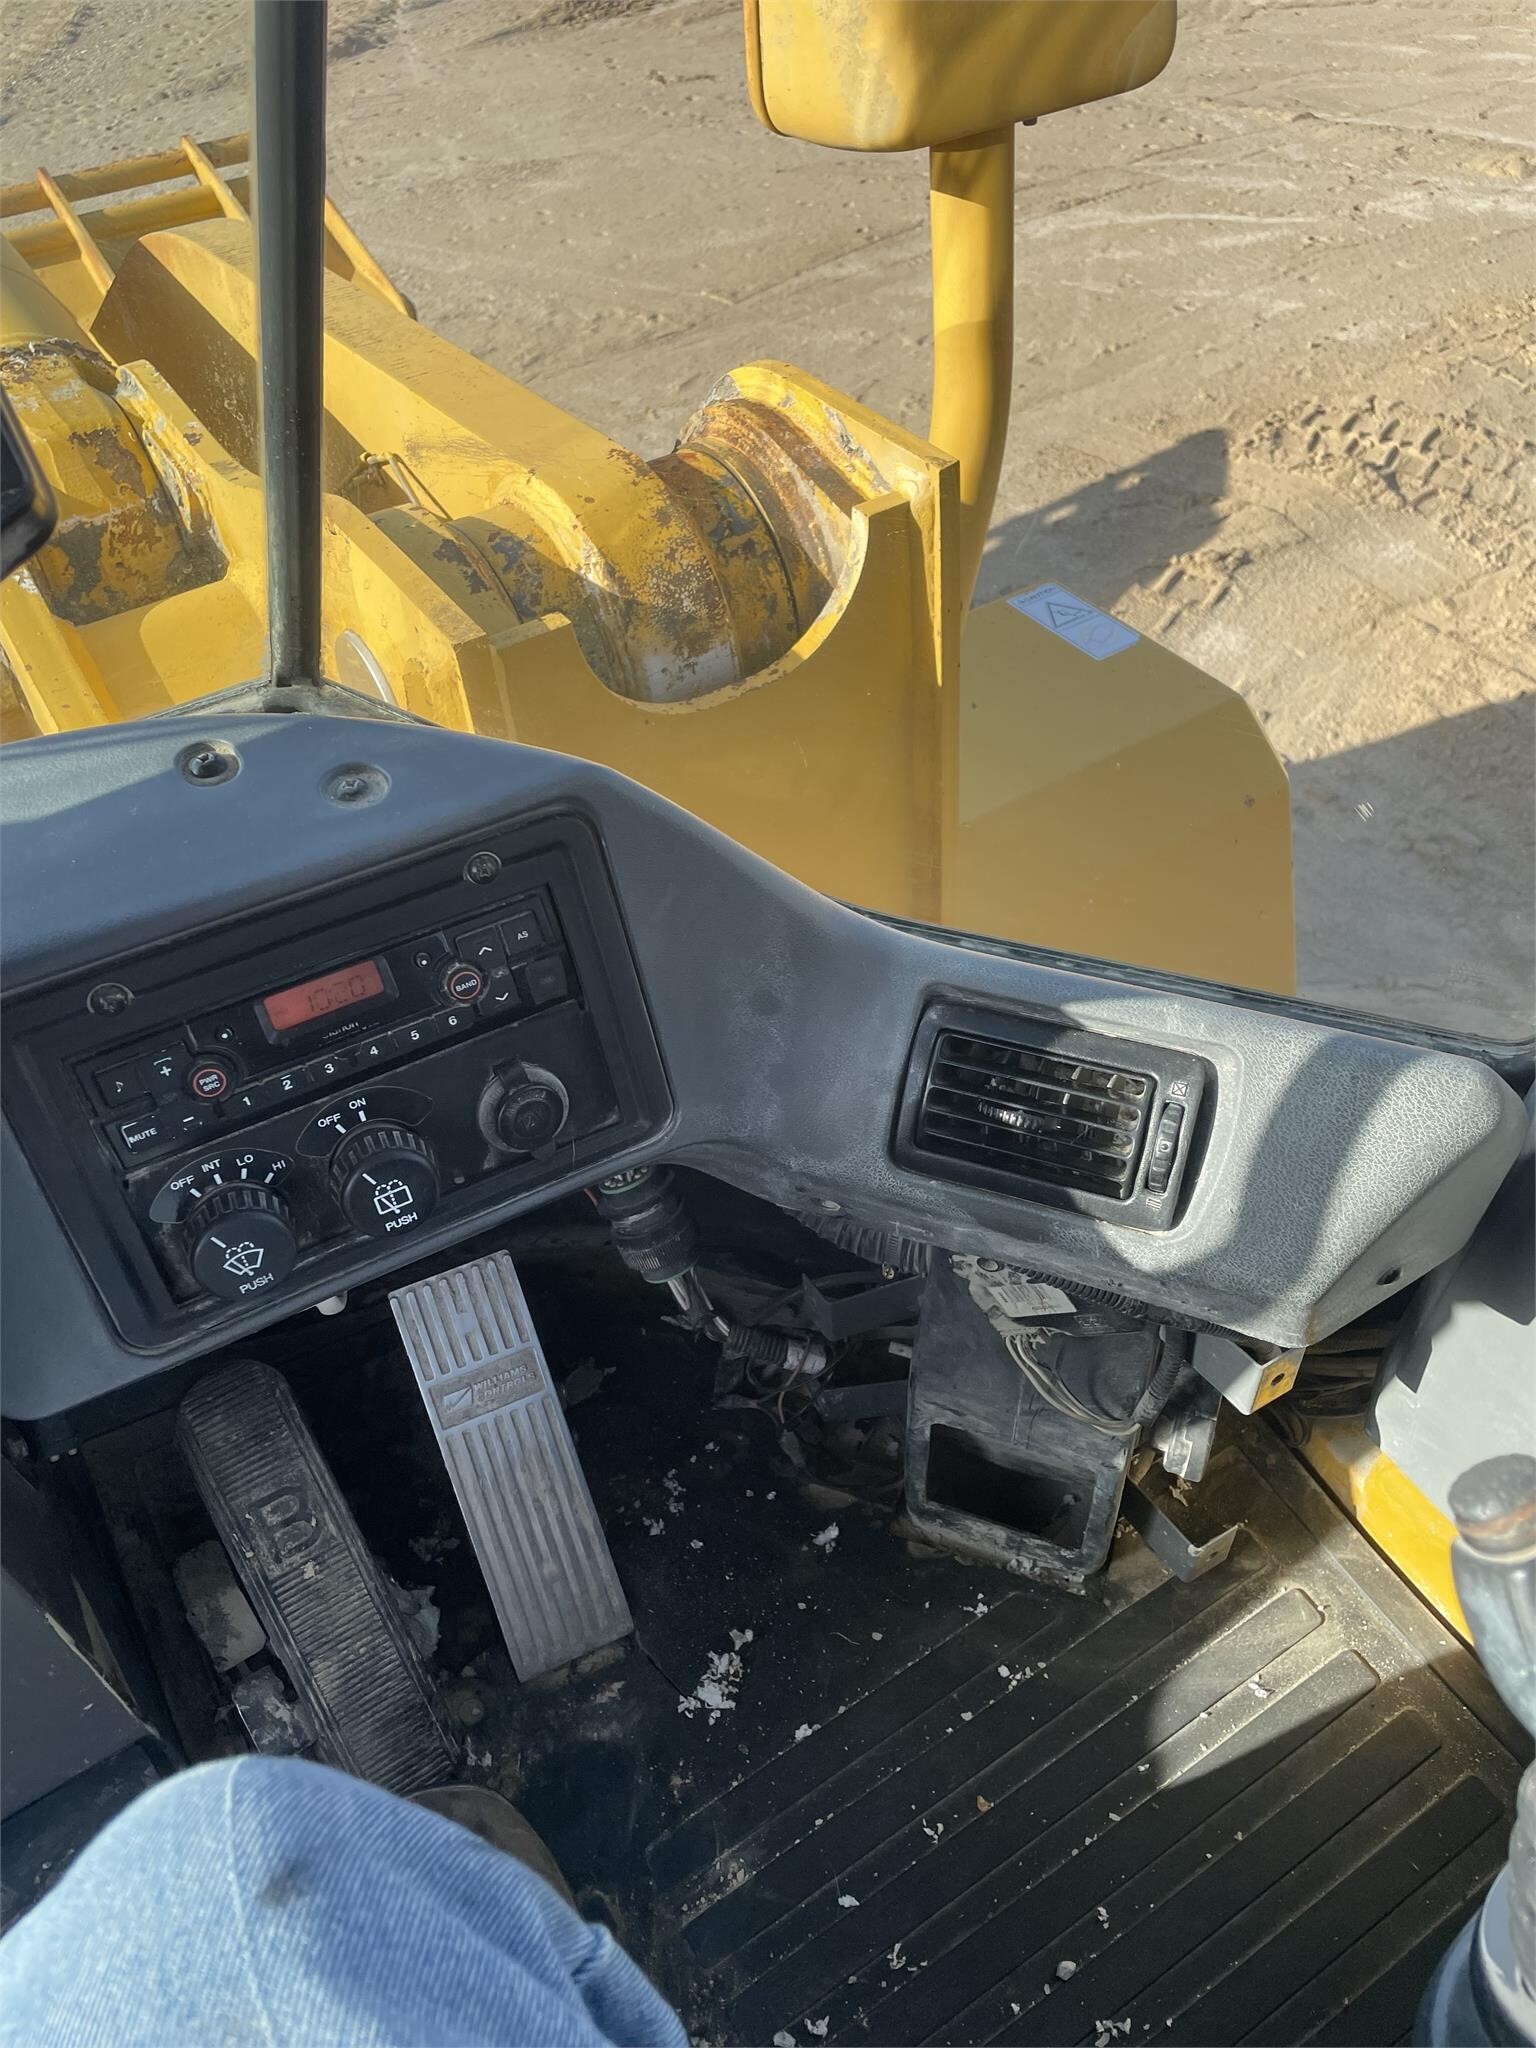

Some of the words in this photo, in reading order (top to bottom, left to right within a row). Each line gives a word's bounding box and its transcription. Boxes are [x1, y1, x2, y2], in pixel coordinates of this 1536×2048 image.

[517, 930, 529, 940] AS
[455, 979, 478, 992] BAND
[242, 1096, 252, 1106] 1
[282, 1079, 293, 1091] 2
[324, 1063, 335, 1074] 3
[369, 1045, 379, 1056] 4
[410, 1030, 420, 1041] 5
[448, 1015, 458, 1026] 6
[199, 1074, 218, 1086] PWR
[202, 1081, 220, 1092] SRC
[317, 1112, 342, 1128] OFF
[348, 1097, 367, 1110] ON
[128, 1127, 158, 1144] MUTE
[170, 1175, 195, 1190] OFF
[201, 1158, 221, 1173] INT
[236, 1154, 254, 1167] LO
[271, 1160, 287, 1171] HI
[384, 1211, 418, 1232] PUSH
[238, 1272, 275, 1295] PUSH
[473, 1364, 528, 1391] WILLIAMS
[477, 1370, 537, 1401] CONTROLS
